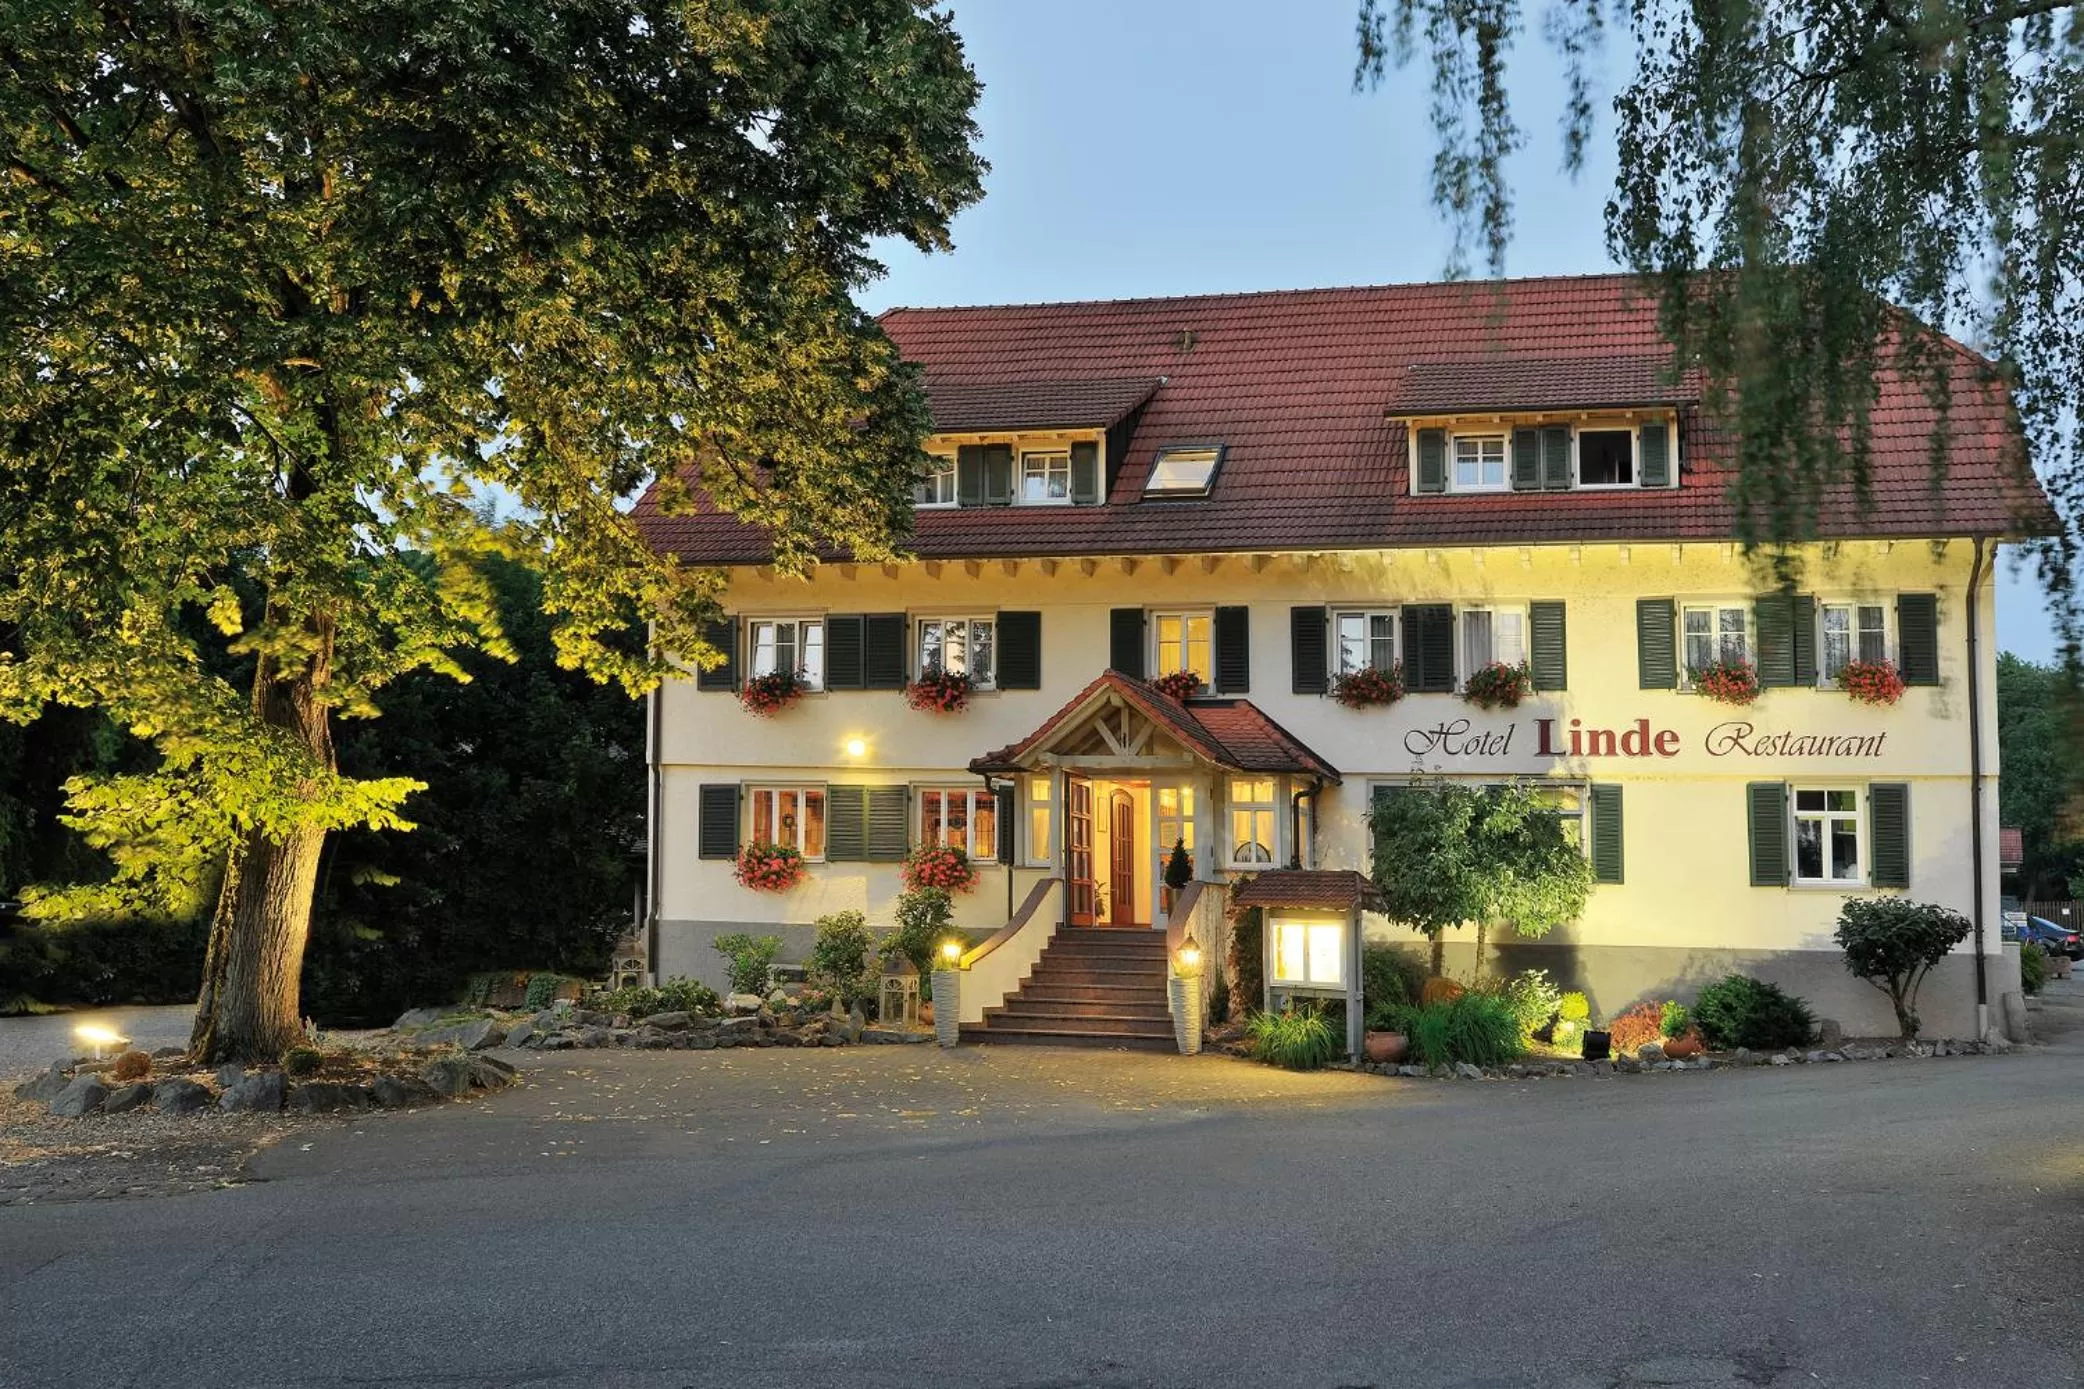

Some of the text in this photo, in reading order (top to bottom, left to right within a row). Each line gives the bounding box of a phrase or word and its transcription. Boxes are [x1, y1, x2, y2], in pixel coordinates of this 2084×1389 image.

[1403, 717, 1887, 758] Hotel Linde Restaurant
